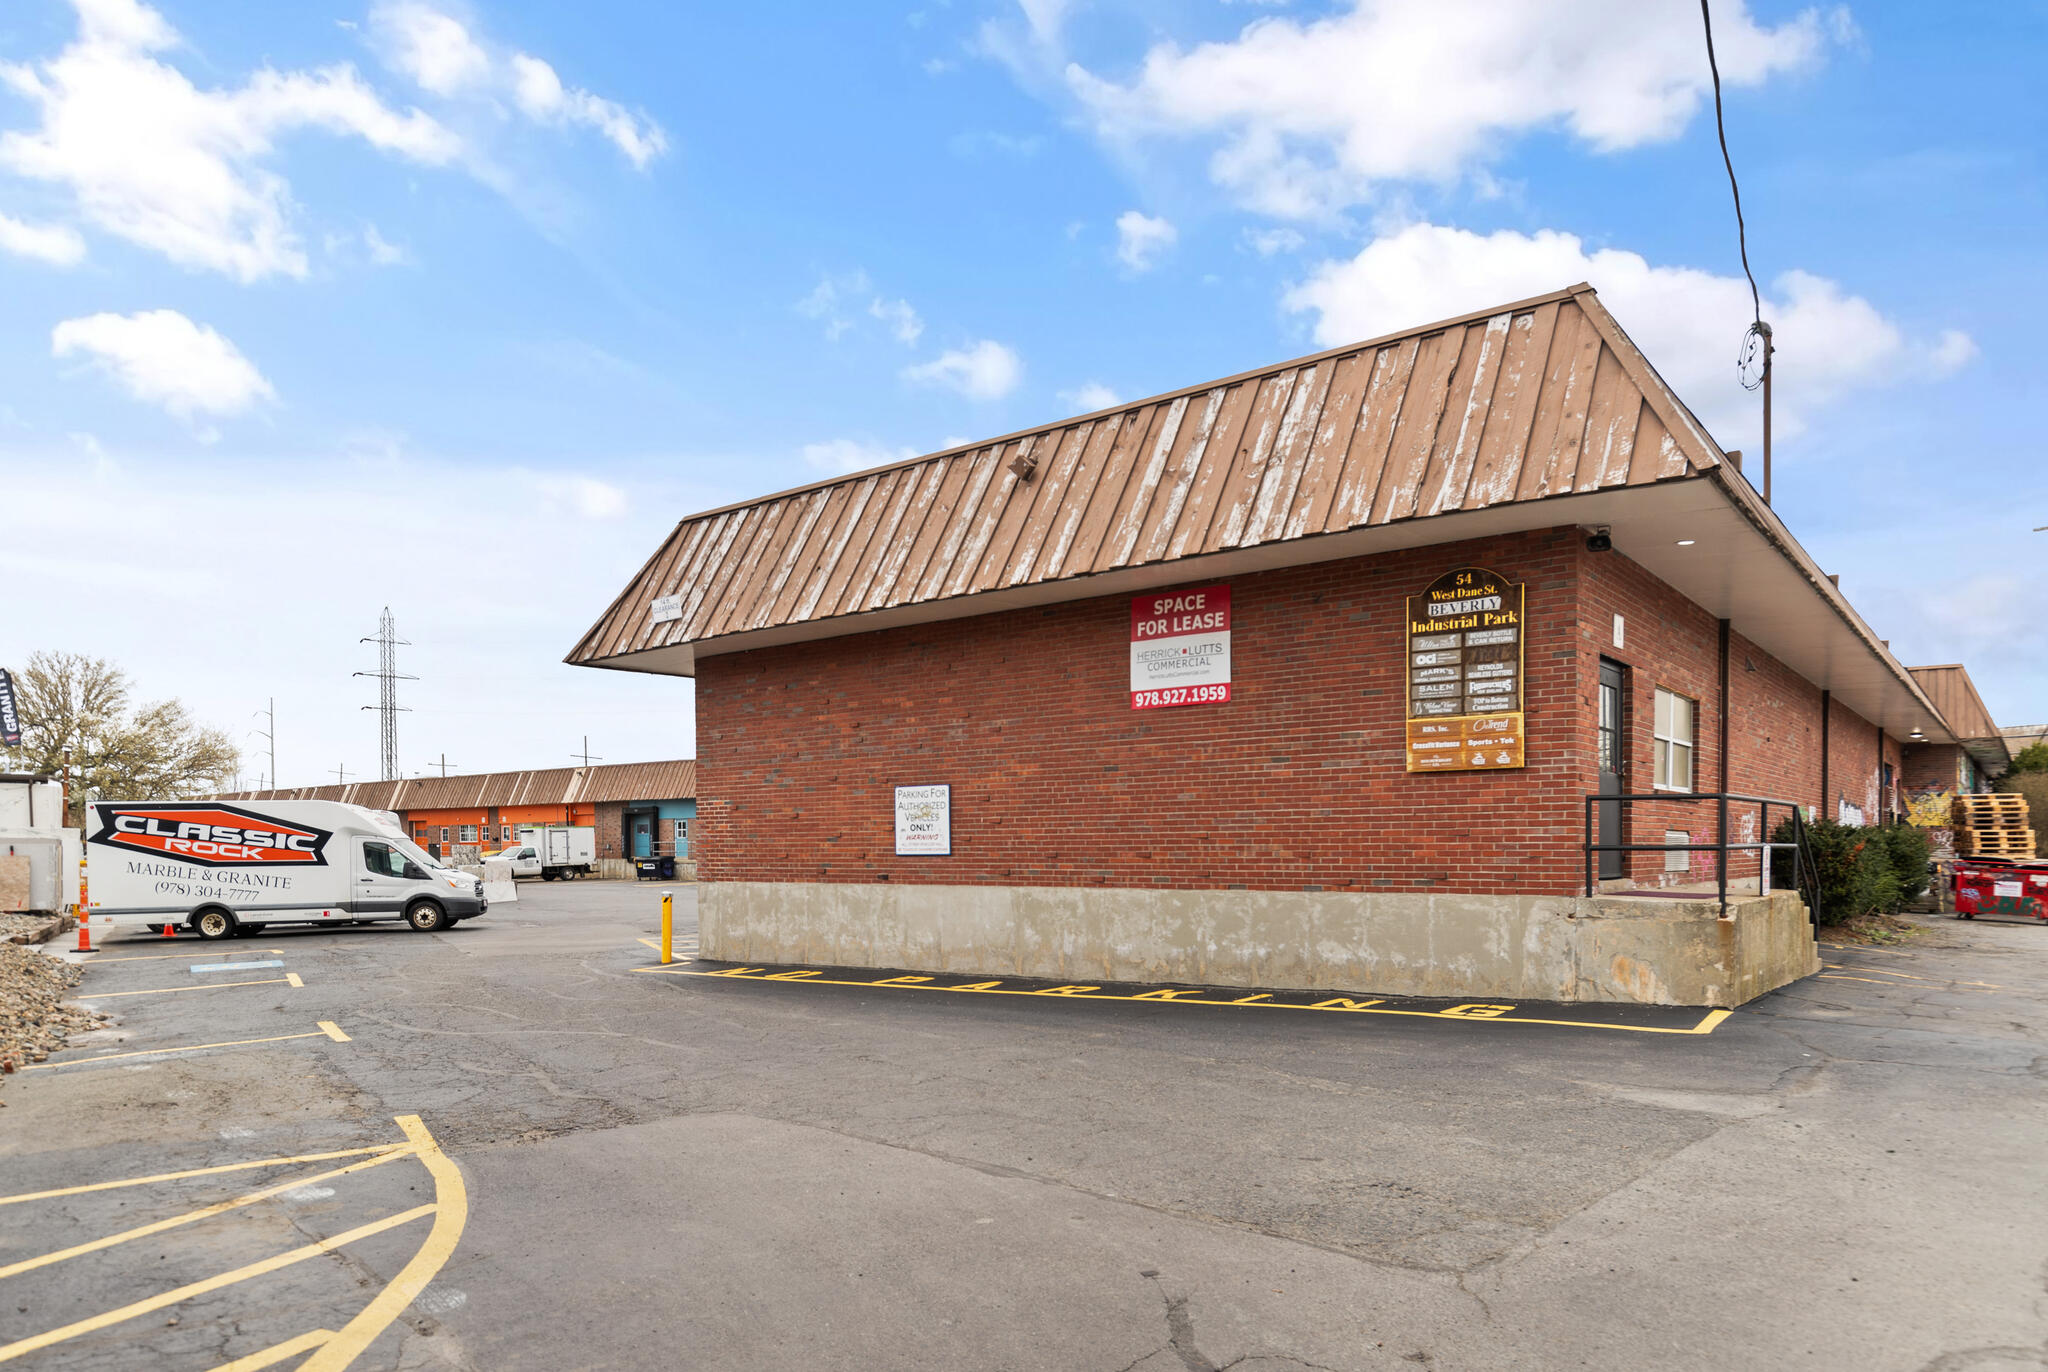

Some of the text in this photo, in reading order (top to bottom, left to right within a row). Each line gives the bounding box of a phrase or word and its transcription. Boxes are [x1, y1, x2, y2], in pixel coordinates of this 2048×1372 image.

[1456, 573, 1472, 585] 54
[1432, 584, 1498, 600] West Dane St.
[1154, 594, 1206, 615] SPACE
[1431, 598, 1499, 616] BEVERLY
[1137, 612, 1224, 637] FOR LEASE
[1412, 610, 1519, 633] Industrial Park
[1137, 643, 1223, 661] HERRICK LUTTS
[1147, 657, 1211, 672] COMMERCIAL
[1136, 685, 1226, 707] 978.927.1959
[1419, 684, 1454, 692] SALEM
[898, 788, 946, 799] PARKING FOR
[115, 816, 316, 852] CLASSIC
[165, 838, 264, 860] ROCK
[127, 862, 292, 890] MARBLE & GRANITE
[155, 881, 259, 902] (978) 304-7777
[709, 968, 1516, 1018] NO PARKING
